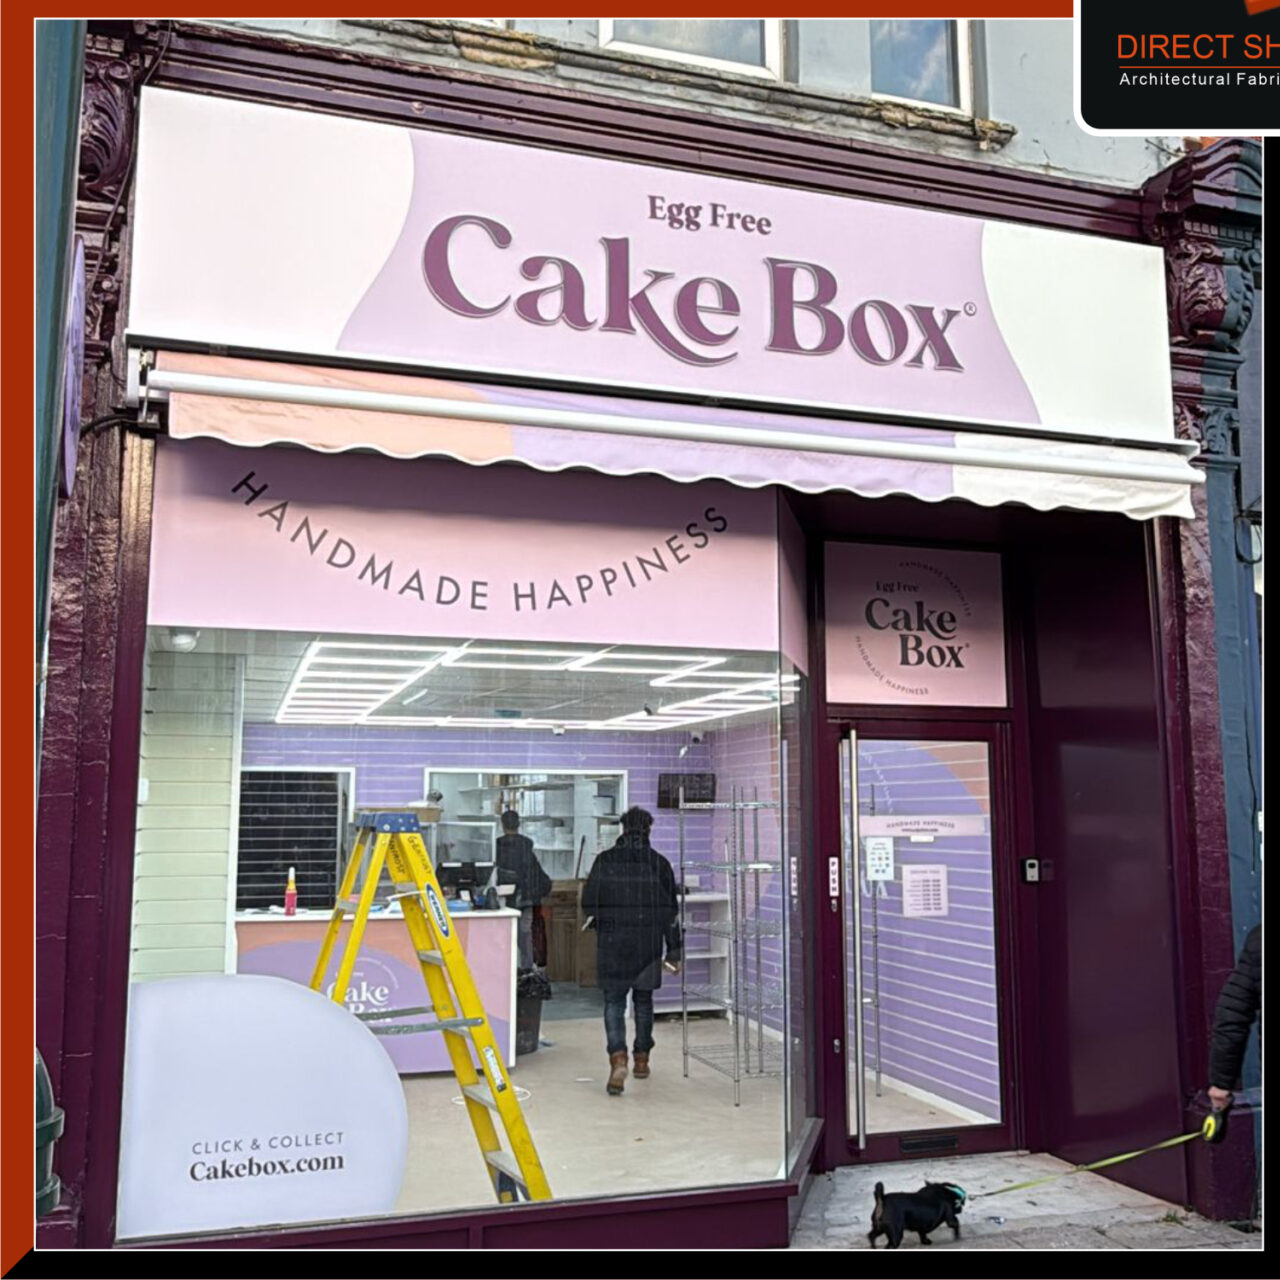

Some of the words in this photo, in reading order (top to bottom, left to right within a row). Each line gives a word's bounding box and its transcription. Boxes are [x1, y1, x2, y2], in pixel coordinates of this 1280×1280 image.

[648, 194, 703, 232] Egg
[709, 201, 773, 236] Free
[422, 214, 742, 368] Cake
[763, 256, 966, 373] Box
[230, 470, 491, 612] HANDMADE
[512, 505, 730, 613] HAPPINESS
[864, 597, 957, 641] Cake
[899, 633, 965, 669] Box
[885, 679, 930, 696] HAPPINESS
[191, 1139, 244, 1156] CLICK
[249, 1138, 261, 1151] &
[268, 1131, 345, 1150] COLLECT
[189, 1154, 345, 1182] Cakebox.com
